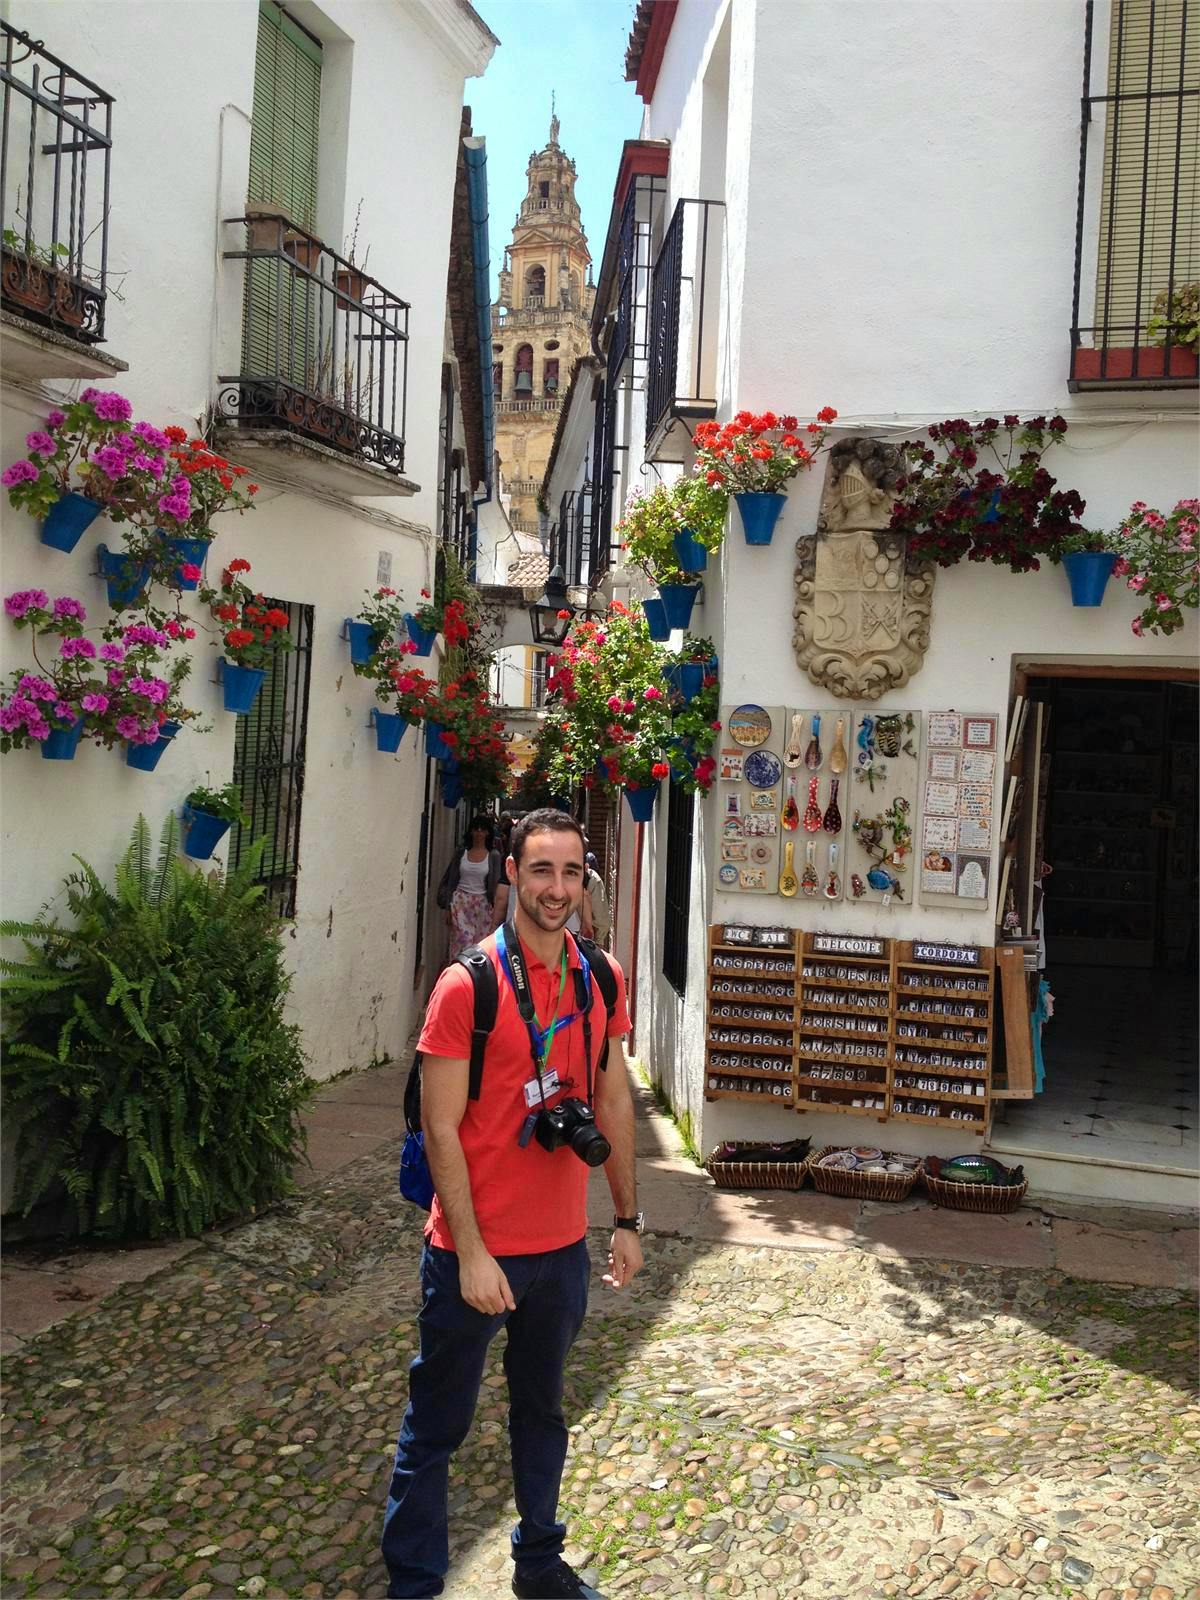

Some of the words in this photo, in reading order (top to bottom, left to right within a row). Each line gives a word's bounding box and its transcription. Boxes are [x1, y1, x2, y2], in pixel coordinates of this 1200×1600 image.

[731, 930, 744, 939] WC
[822, 940, 876, 951] WELCOME
[921, 947, 969, 960] CORDOBA
[511, 955, 526, 990] Canon
